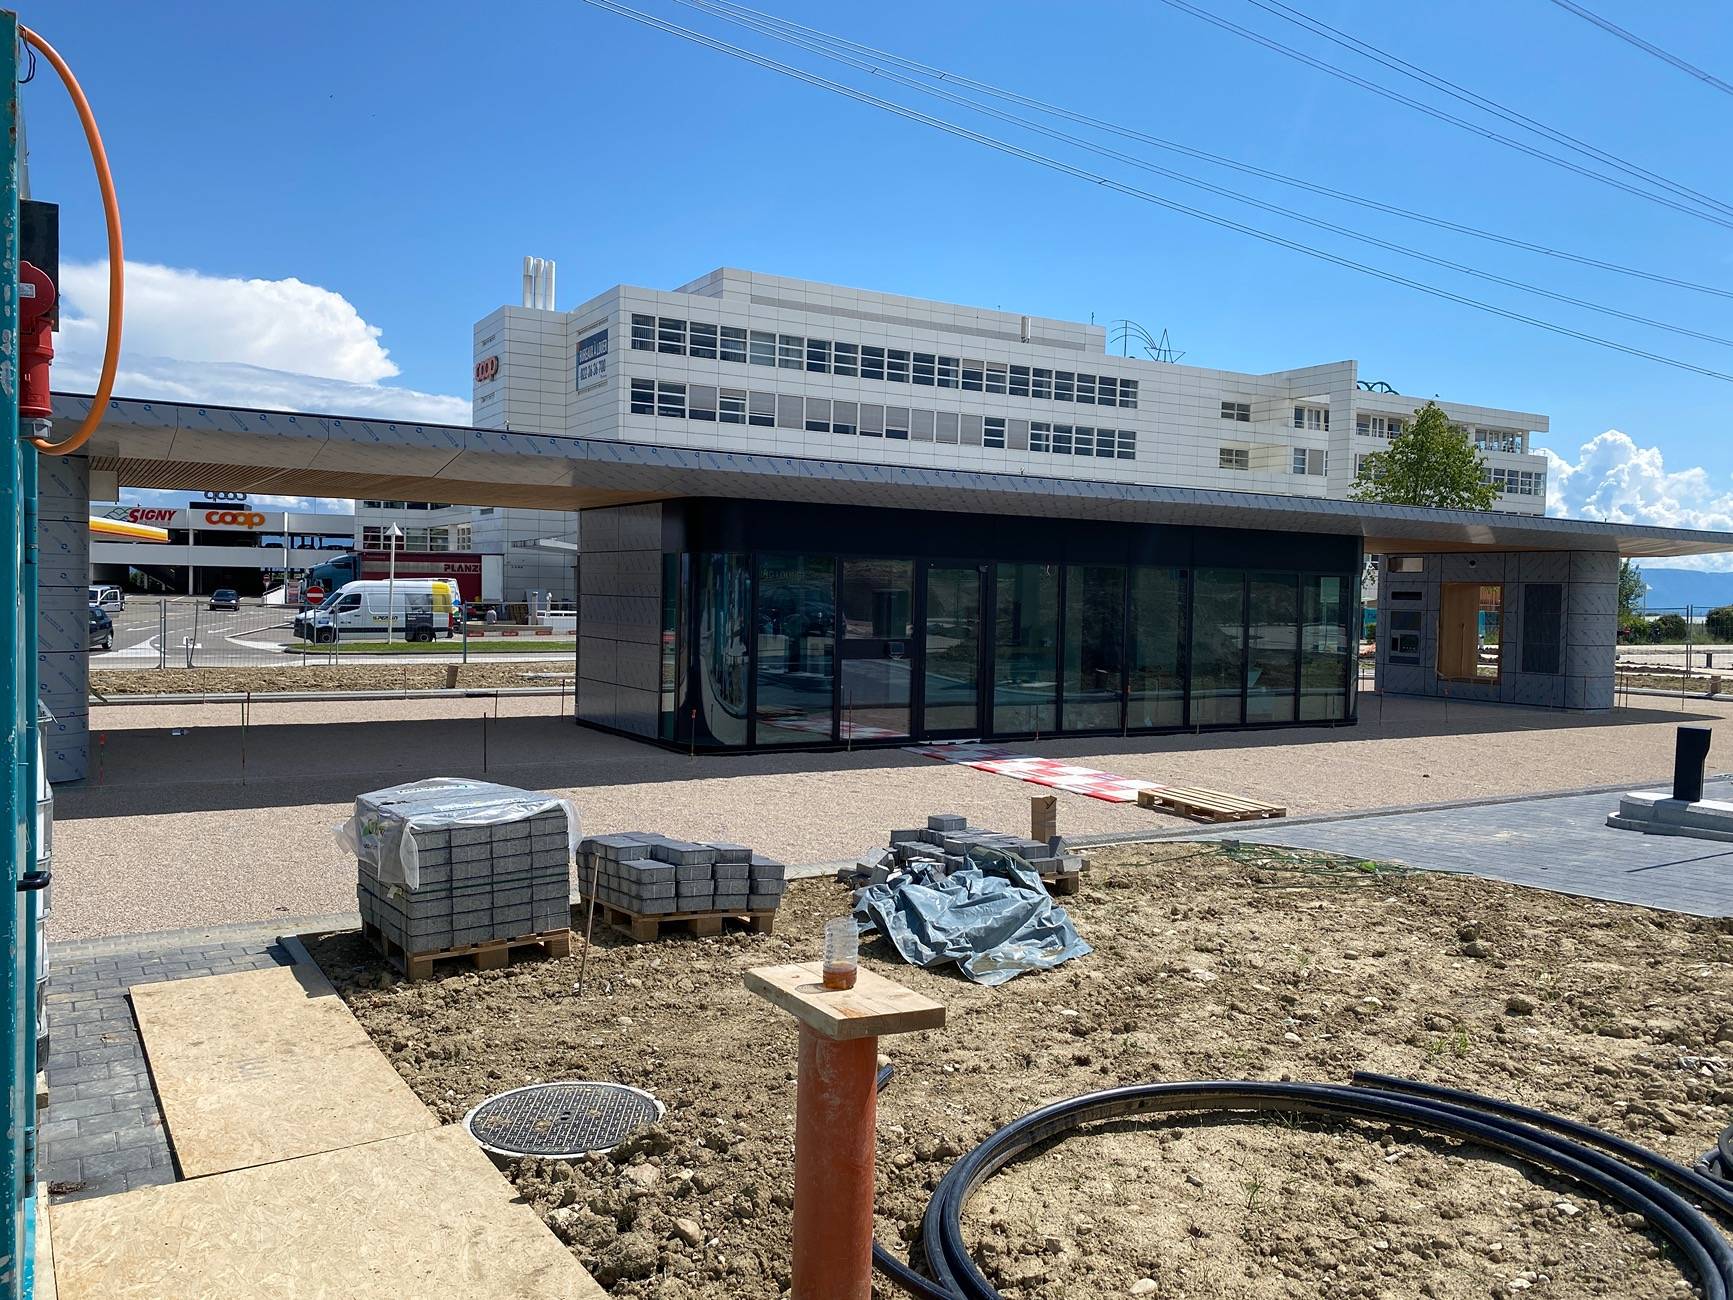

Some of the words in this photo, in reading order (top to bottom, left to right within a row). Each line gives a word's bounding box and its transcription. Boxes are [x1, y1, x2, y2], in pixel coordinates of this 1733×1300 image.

[475, 355, 498, 382] coop
[128, 508, 176, 524] SIGNY
[205, 511, 266, 529] coop
